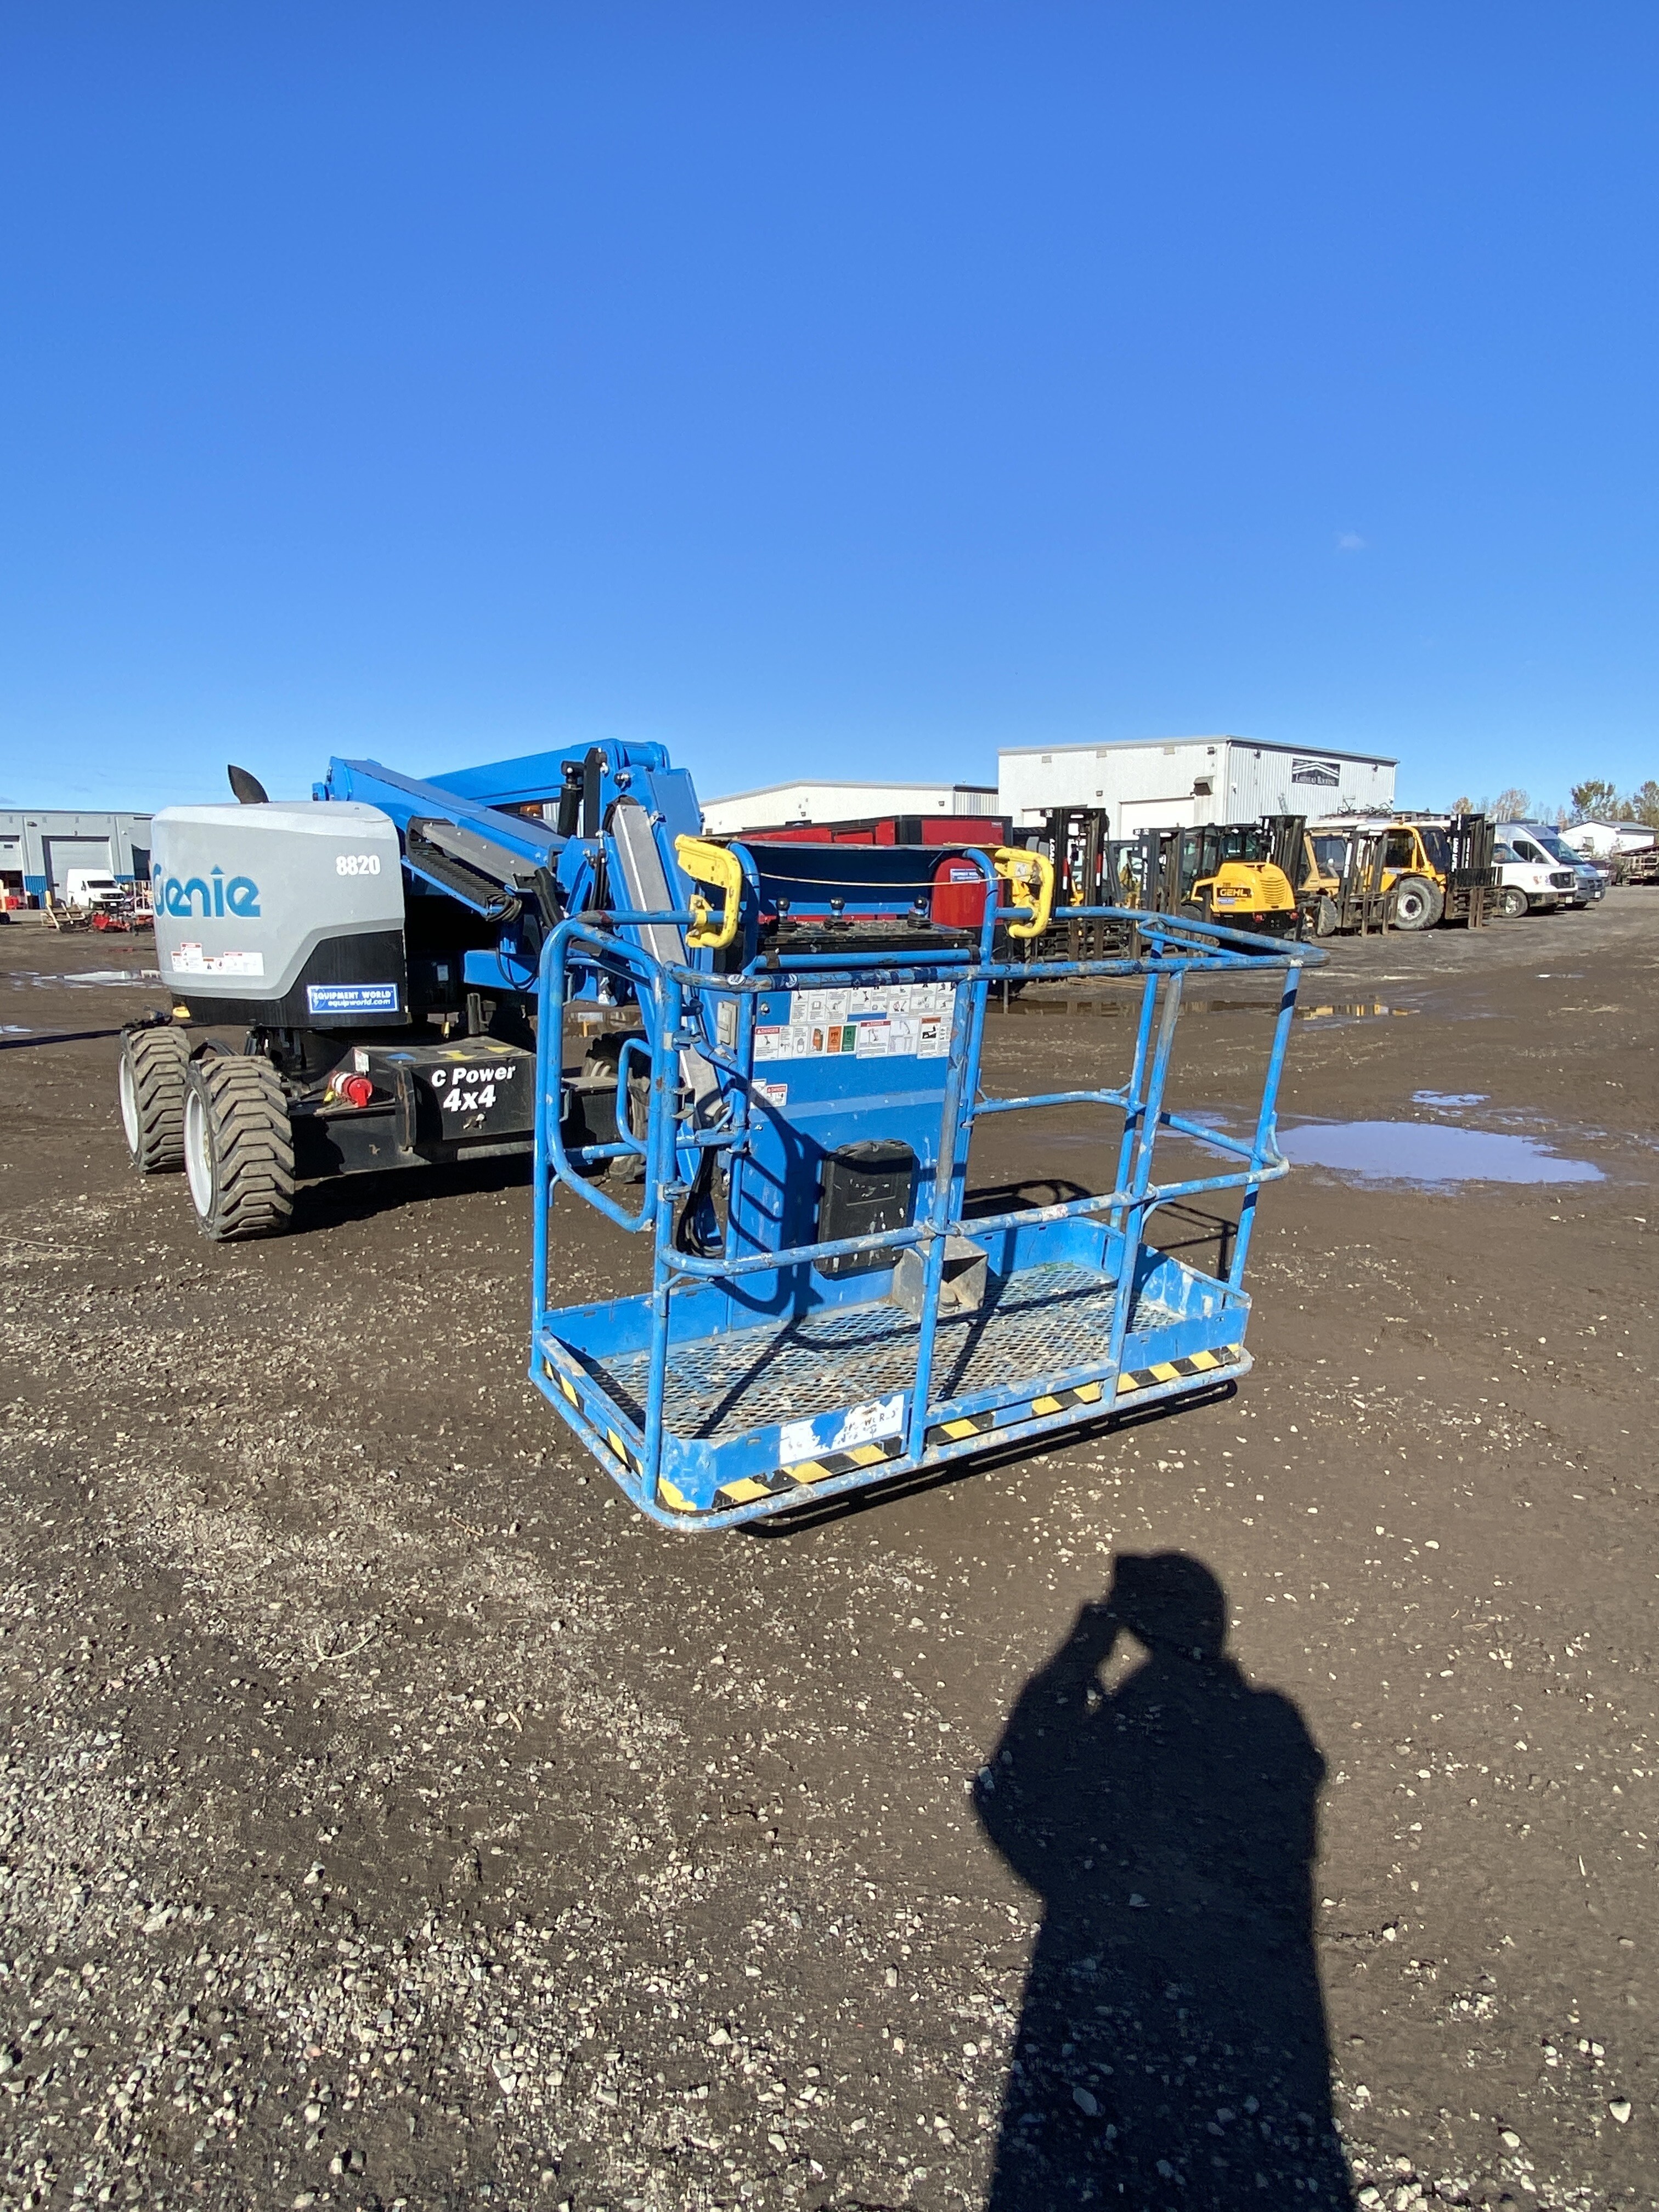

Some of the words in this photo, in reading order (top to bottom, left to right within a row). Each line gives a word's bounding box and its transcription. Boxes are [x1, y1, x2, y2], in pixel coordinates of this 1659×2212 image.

[335, 855, 381, 876] 8820
[1220, 888, 1248, 897] GEHL
[313, 991, 359, 1000] EQUIPMENT
[362, 990, 392, 998] WORLD
[328, 998, 391, 1007] equipworld.com
[431, 1069, 447, 1087] C
[452, 1065, 516, 1086] Power
[443, 1084, 496, 1112] 4x4
